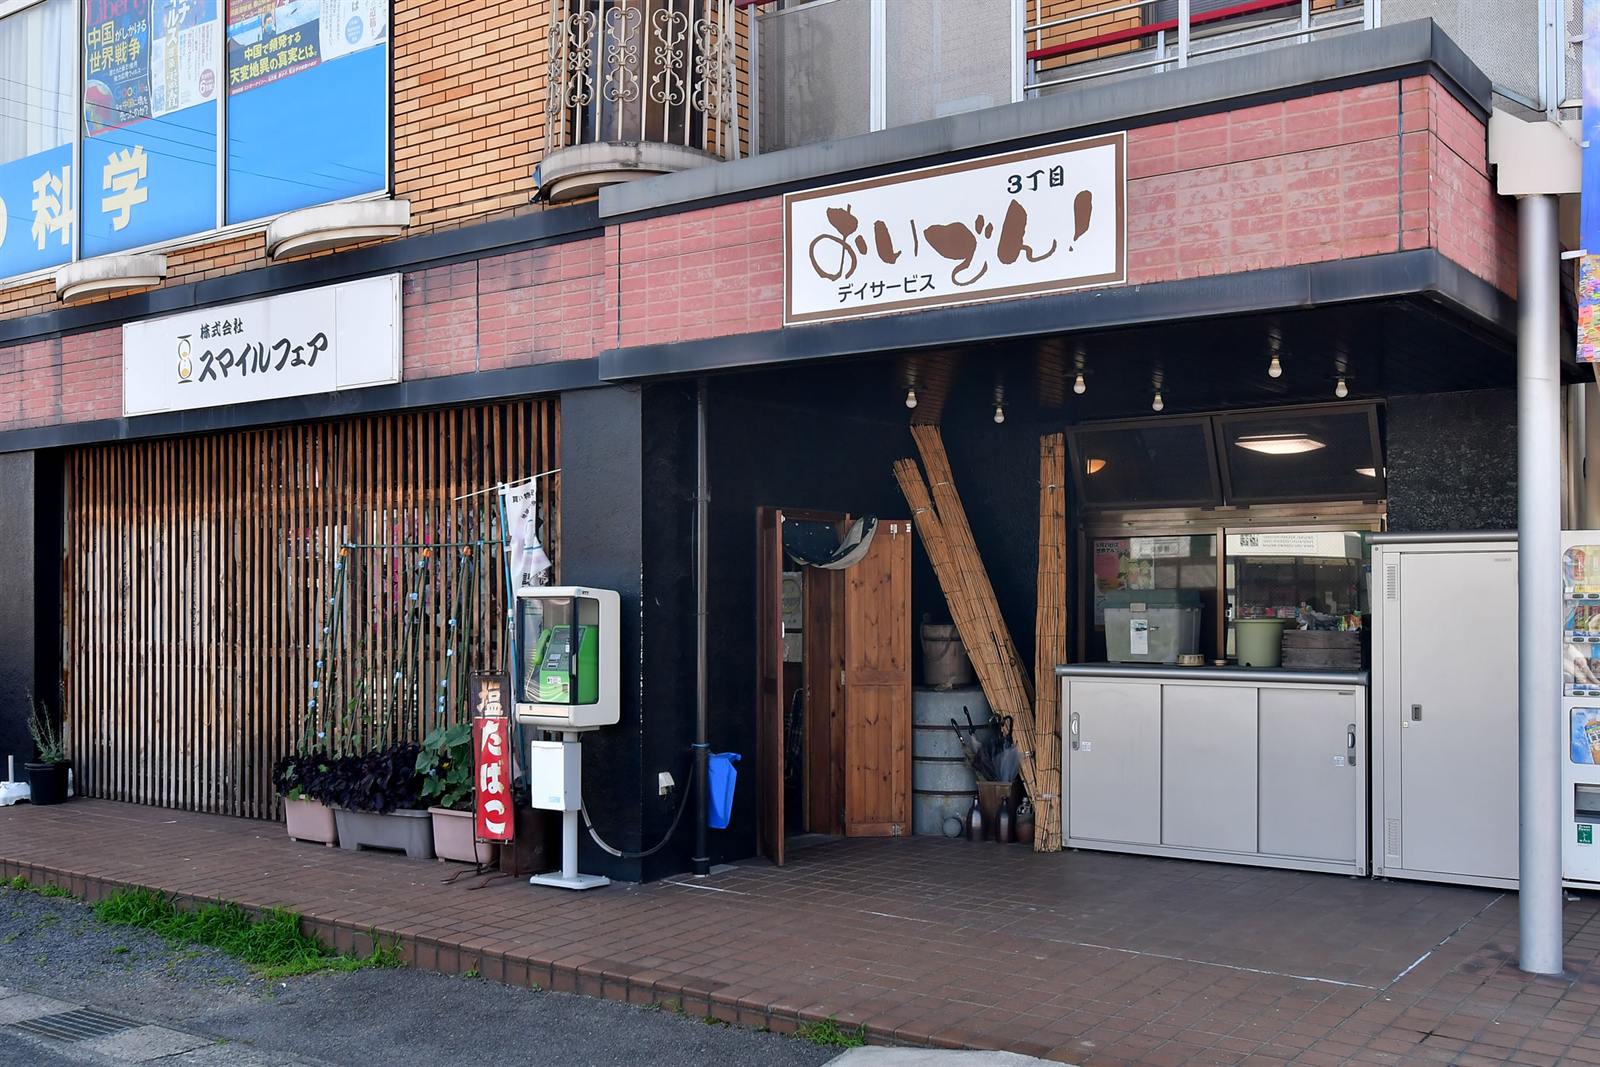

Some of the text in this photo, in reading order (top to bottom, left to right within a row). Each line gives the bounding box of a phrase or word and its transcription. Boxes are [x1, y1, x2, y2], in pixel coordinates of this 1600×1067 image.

[88, 19, 147, 49] 中国がしかける
[244, 31, 302, 60] 中国で頻発する
[89, 38, 140, 73] 世界戦争
[1007, 165, 1065, 194] 3丁目
[0, 145, 148, 250] 科学
[838, 274, 935, 302] デイサービス
[200, 318, 244, 340] 株式会社
[198, 332, 328, 382] スマイルフェア
